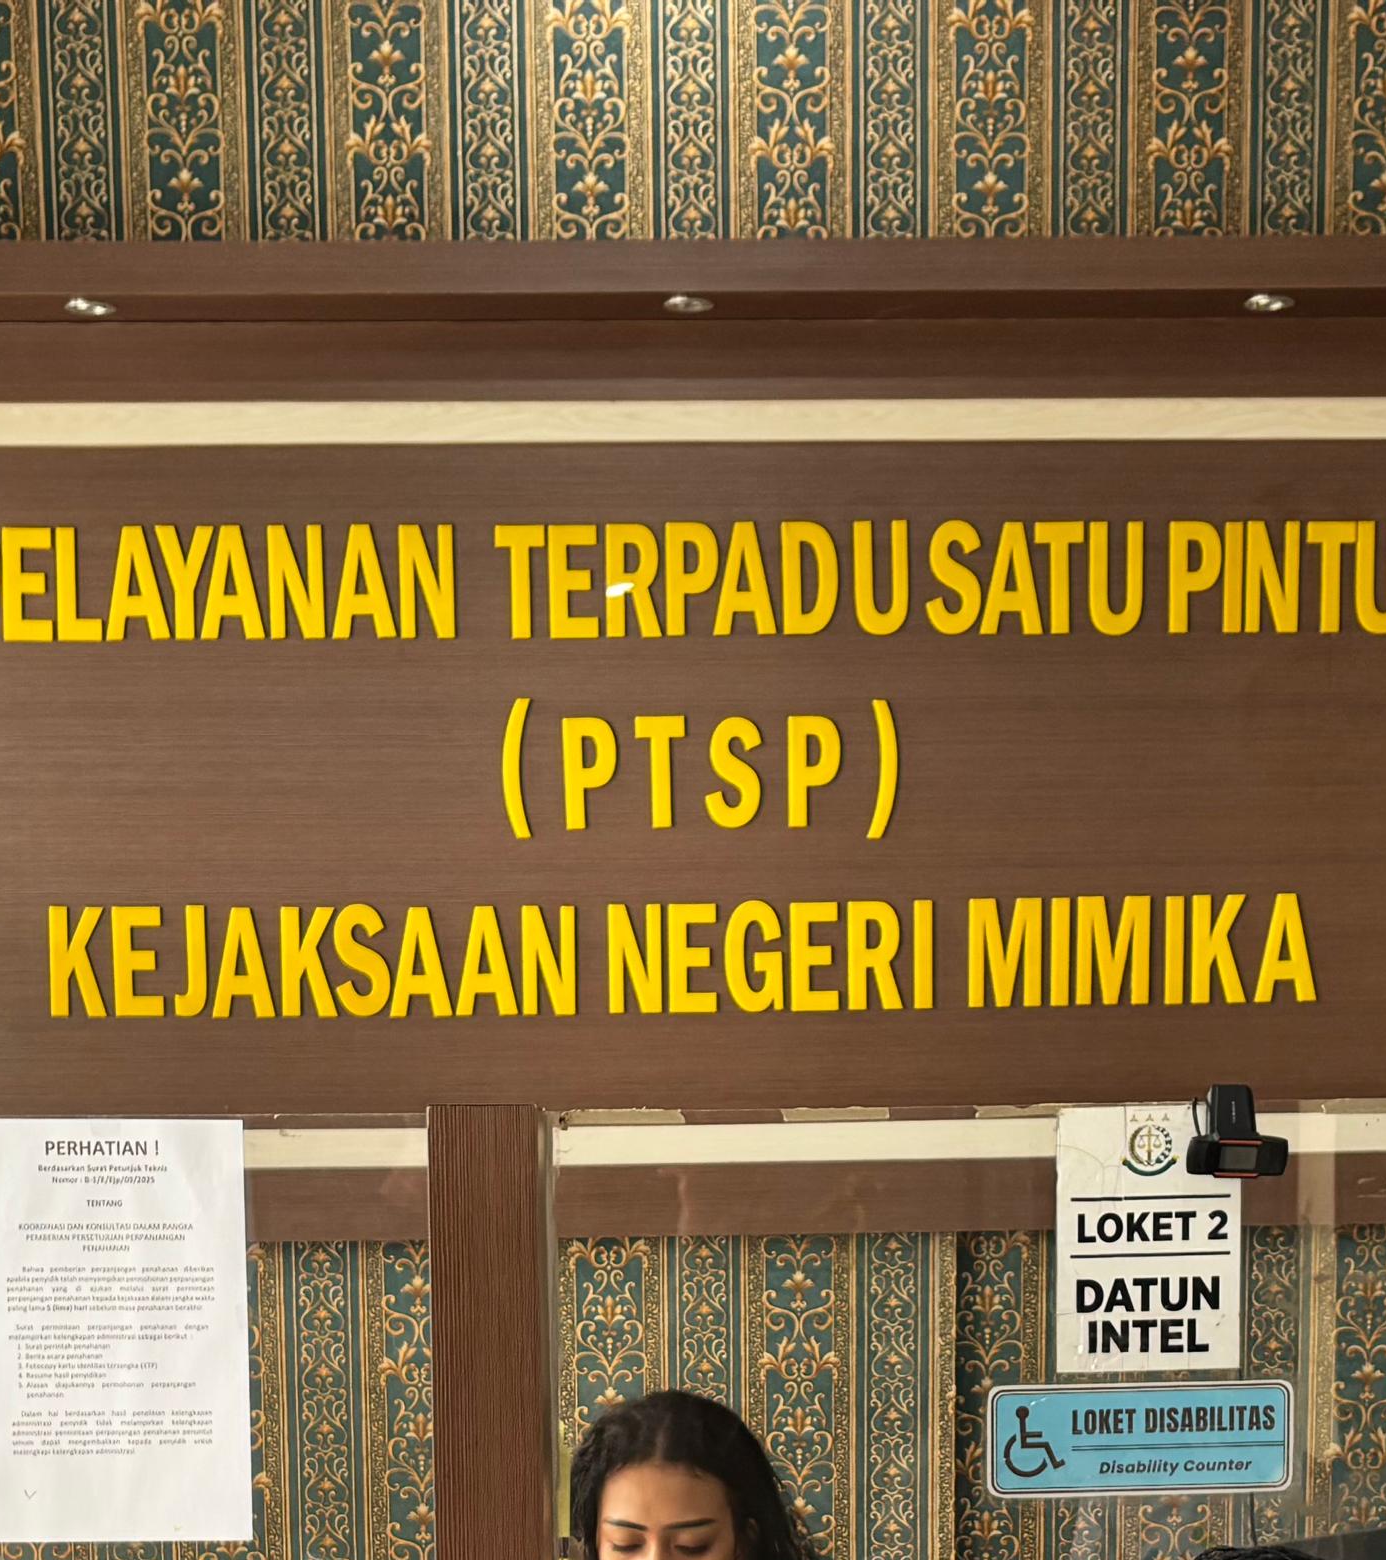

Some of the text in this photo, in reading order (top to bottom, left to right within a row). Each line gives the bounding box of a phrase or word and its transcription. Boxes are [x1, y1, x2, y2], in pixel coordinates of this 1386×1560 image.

[495, 519, 907, 640] TERPADU
[926, 519, 1144, 637] SATU
[48, 892, 1317, 1019] KEJAKSAAN NEGERI MIMIKA
[44, 1140, 159, 1156] PERHATIAN !
[86, 1199, 123, 1207] TENTANG
[1077, 1209, 1229, 1243] LOKET 2
[1076, 1275, 1220, 1313] DATUN
[1088, 1318, 1209, 1354] INTEL
[1071, 1405, 1275, 1435] LOKET DISABILITAS
[1099, 1458, 1252, 1477] Disability Counter
